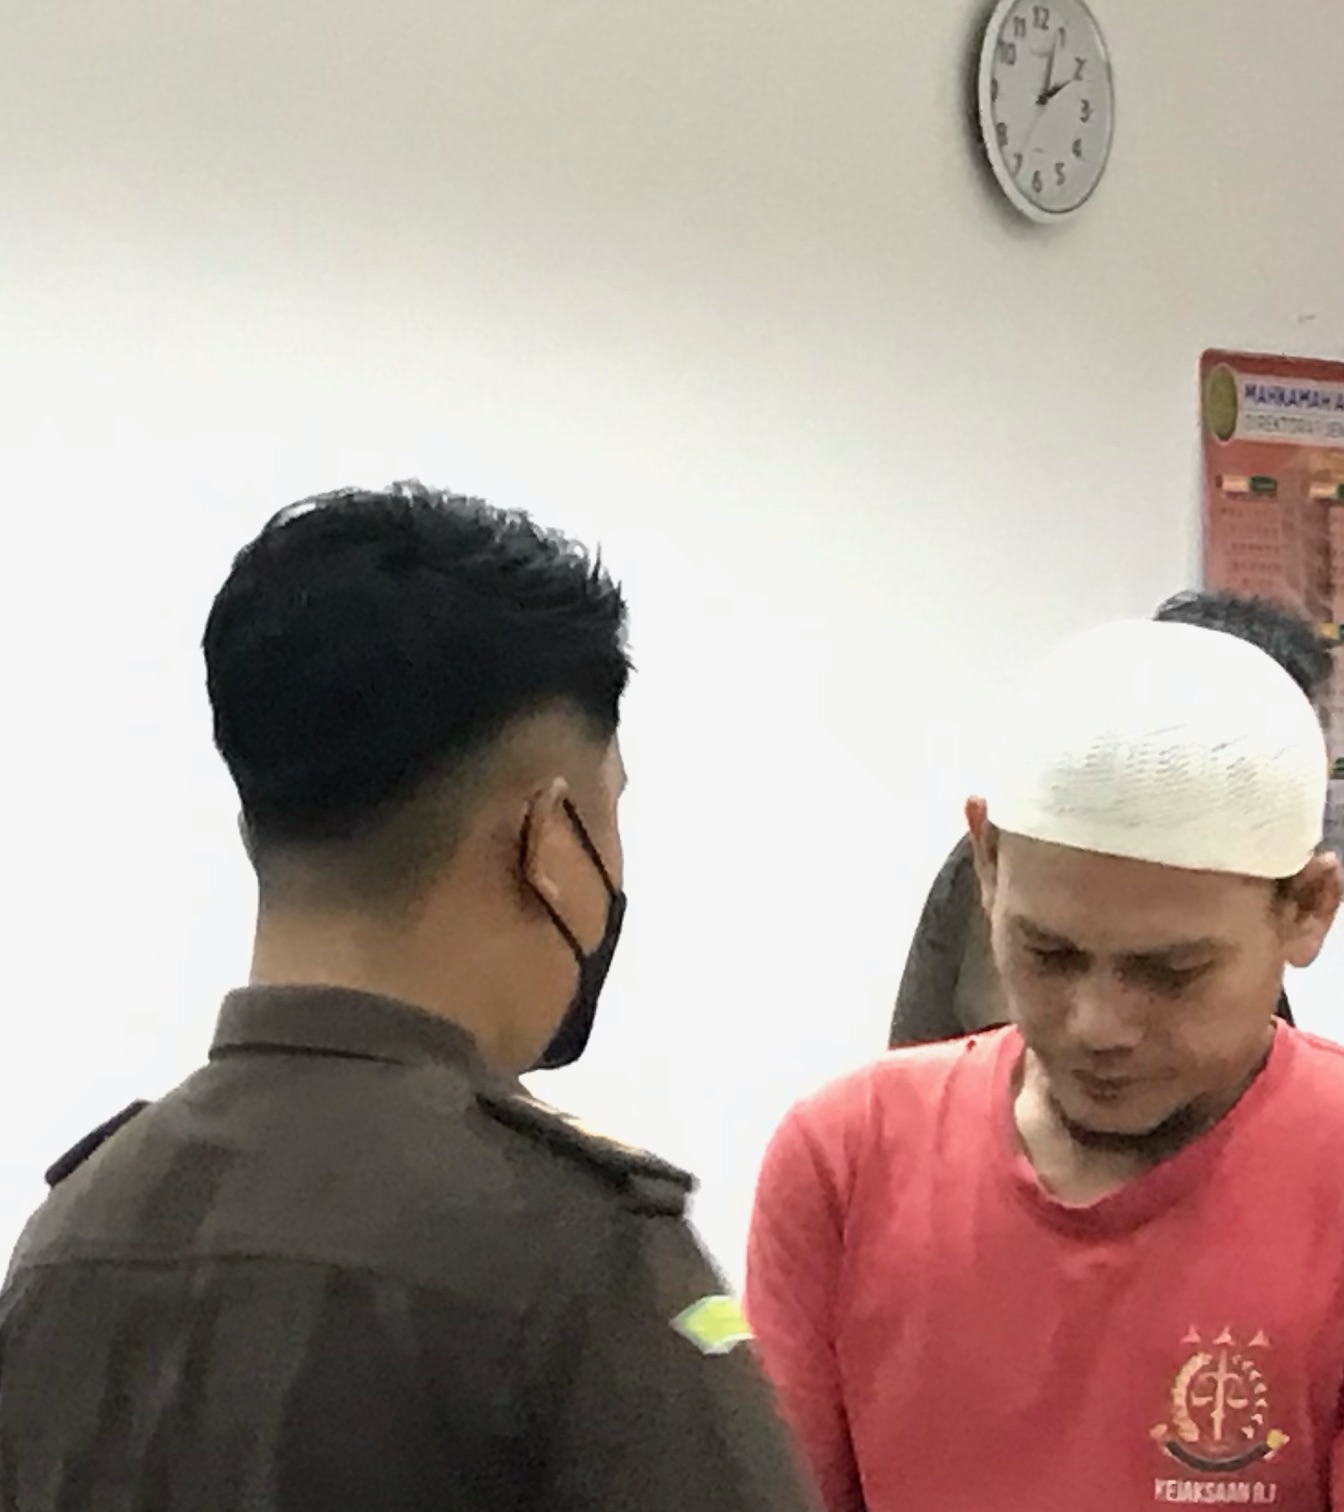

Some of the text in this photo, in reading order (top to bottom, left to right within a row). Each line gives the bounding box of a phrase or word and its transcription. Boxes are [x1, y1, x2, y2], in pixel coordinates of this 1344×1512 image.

[1032, 5, 1050, 31] 12
[1058, 26, 1066, 49] 1
[1074, 56, 1087, 81] 2
[1080, 99, 1092, 123] 3
[1031, 170, 1043, 193] 6
[1055, 161, 1066, 186] 5
[1244, 383, 1331, 410] MAHKAMAH
[1155, 1479, 1250, 1503] KEJAKSAAN
